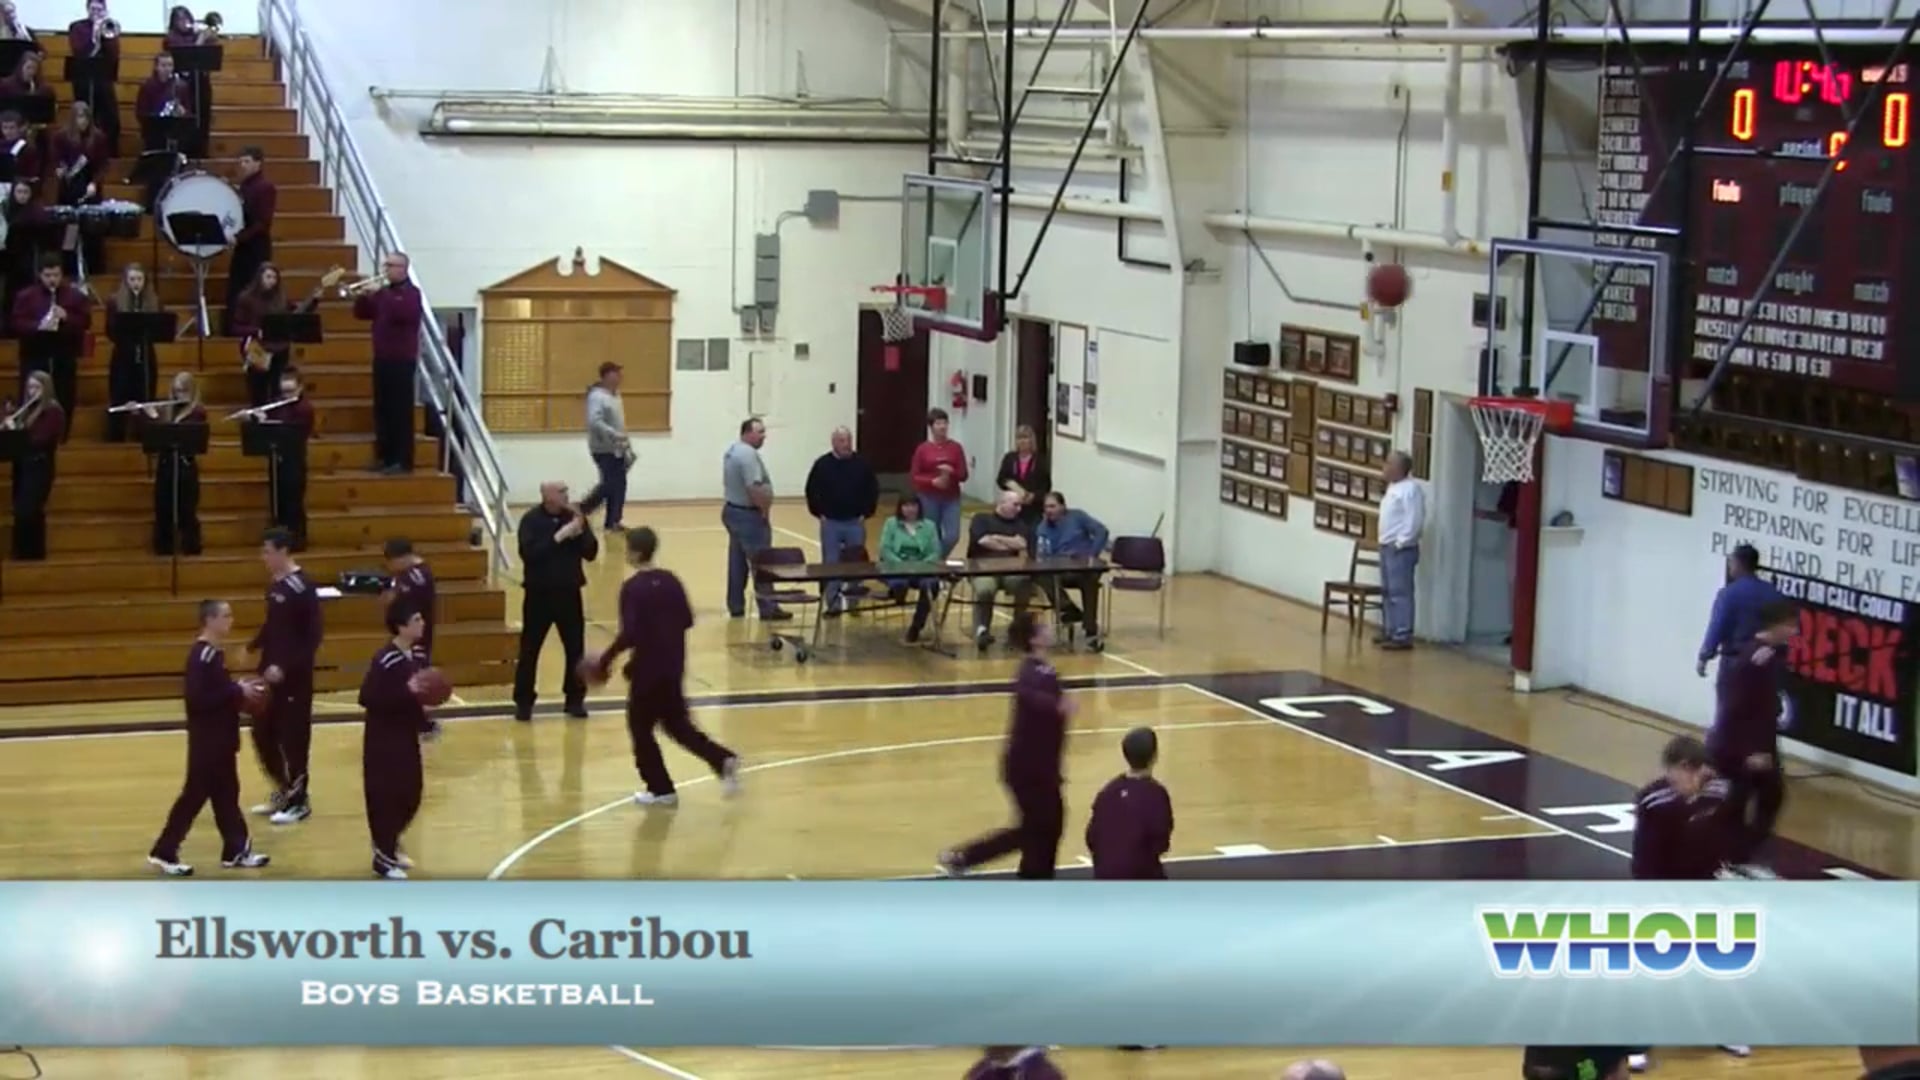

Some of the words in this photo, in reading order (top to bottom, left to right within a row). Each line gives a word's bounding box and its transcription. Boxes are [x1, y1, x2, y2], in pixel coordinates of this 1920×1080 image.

[1732, 88, 1754, 140] 0
[1883, 92, 1908, 147] 0
[1700, 468, 1780, 504] STRIVING
[1793, 486, 1829, 515] FOR
[1723, 503, 1825, 547] PREPARING
[1836, 528, 1873, 558] FOR
[1775, 574, 1805, 599] TEXT
[1826, 585, 1858, 613] CALL
[1859, 593, 1904, 624] COULD
[1787, 606, 1903, 700] RECK
[1833, 692, 1858, 731] IT
[1857, 699, 1897, 744] ALL
